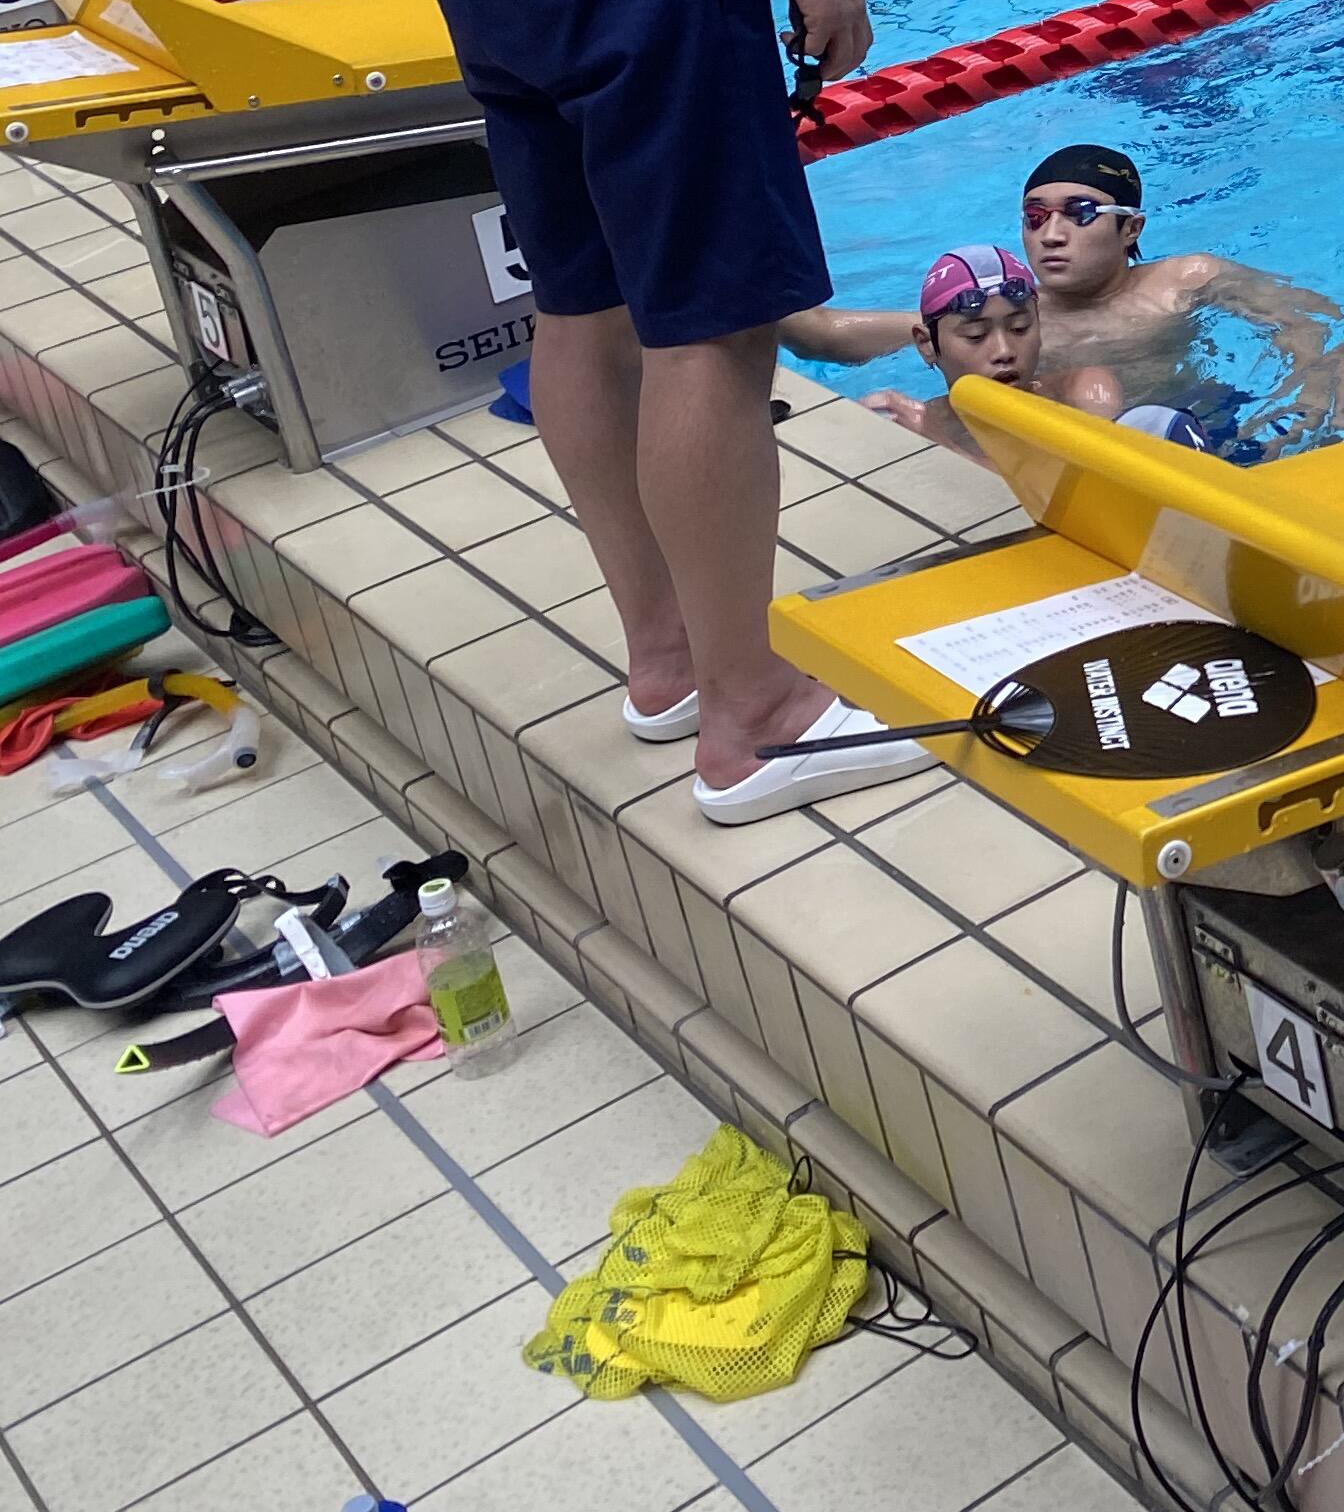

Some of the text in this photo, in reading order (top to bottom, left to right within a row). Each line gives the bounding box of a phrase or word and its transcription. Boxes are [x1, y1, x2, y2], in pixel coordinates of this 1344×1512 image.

[199, 294, 220, 348] 5
[1082, 658, 1131, 751] WATER INSTINCT
[1202, 658, 1260, 718] arena
[108, 911, 179, 960] arena
[1266, 1017, 1317, 1108] 4
